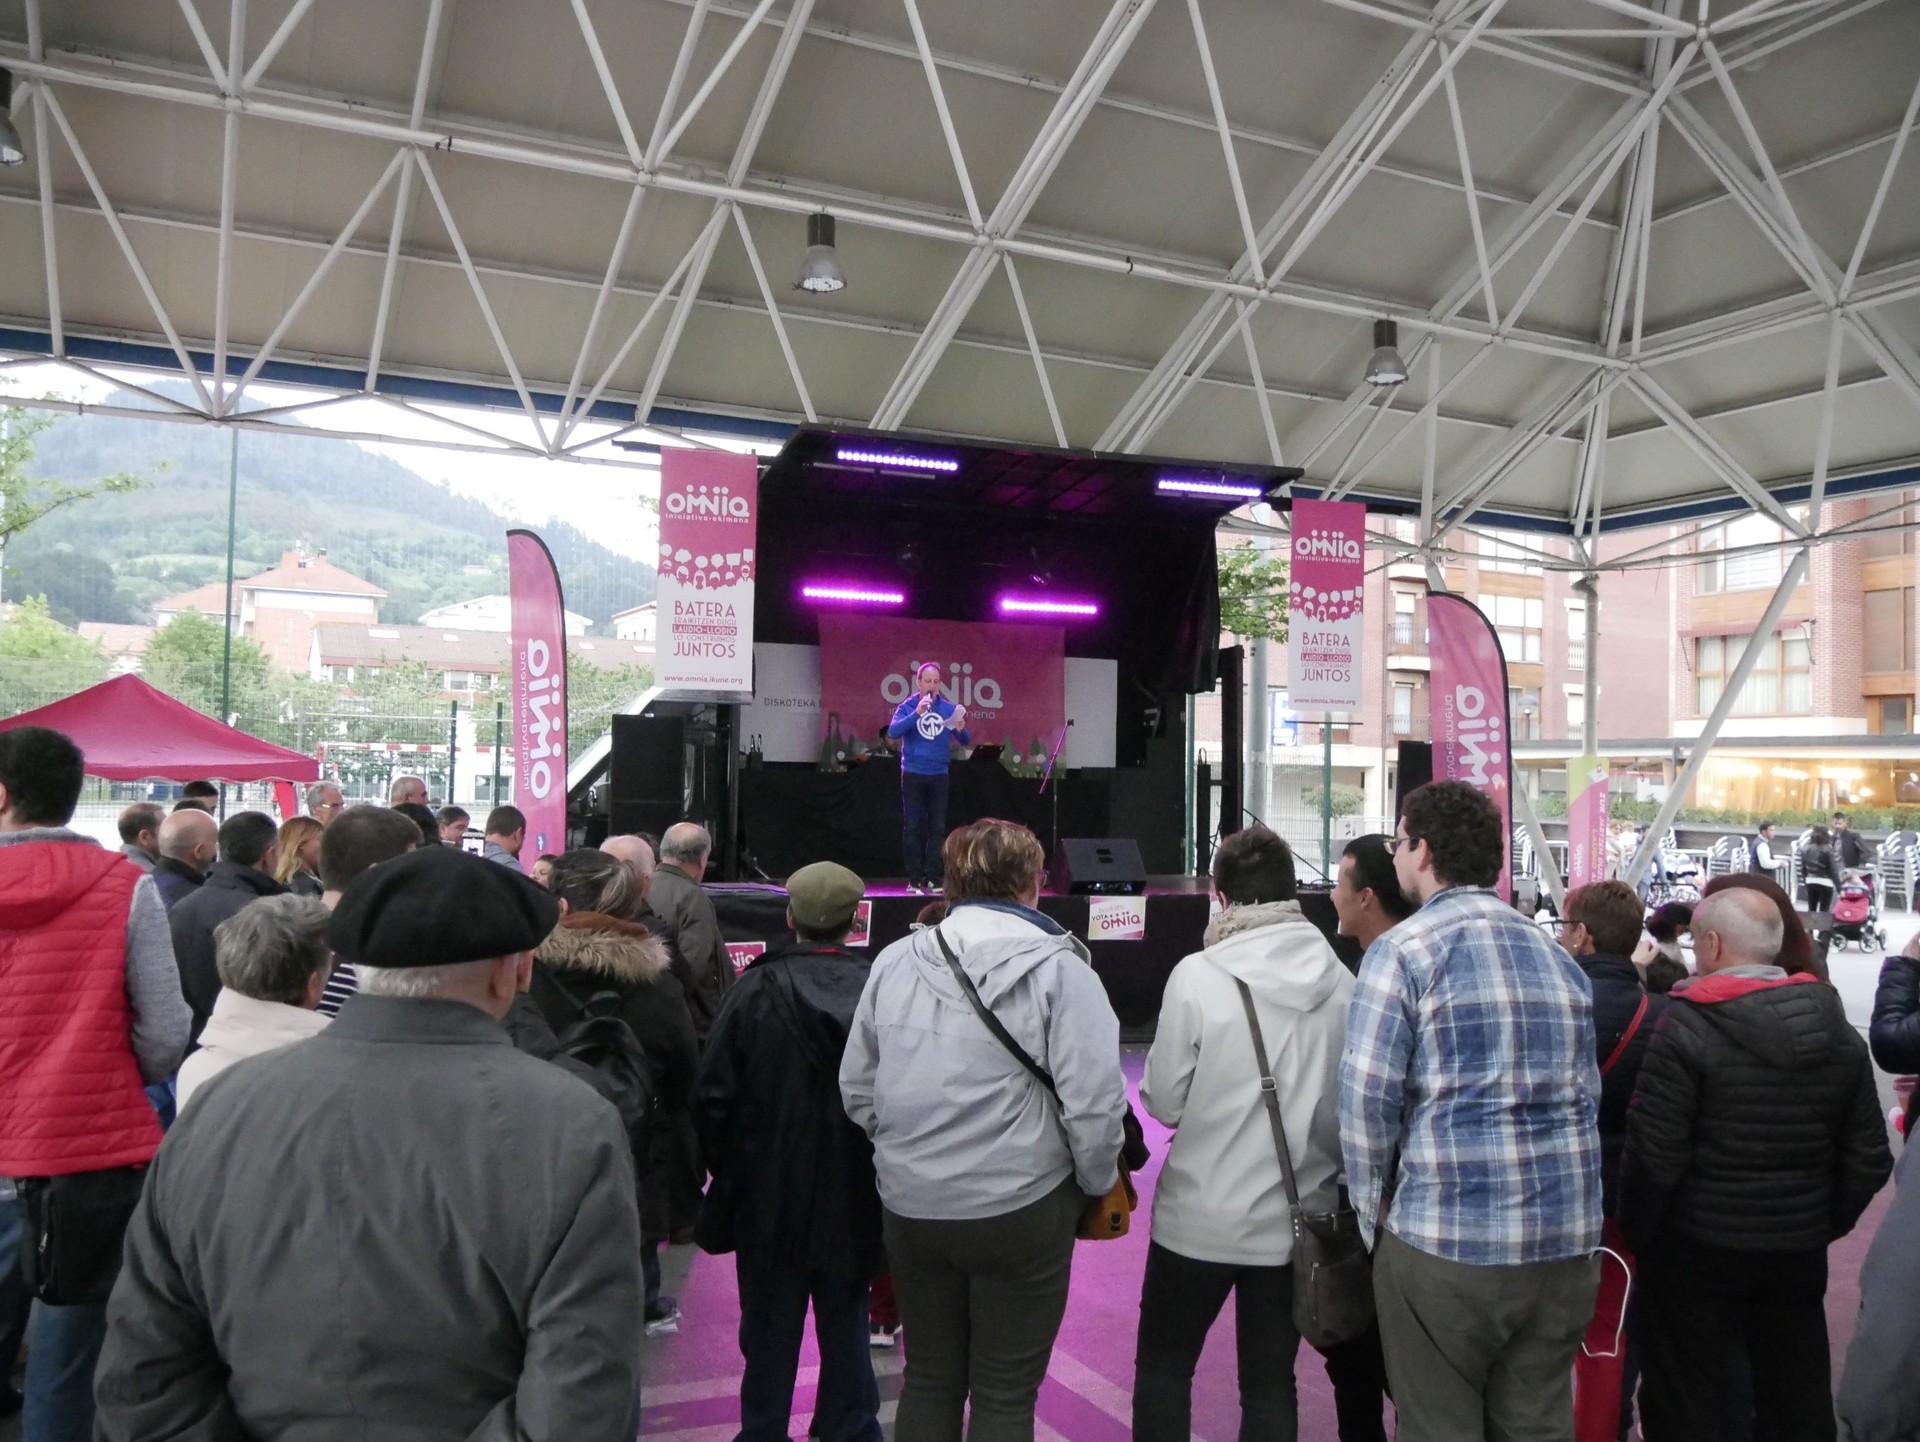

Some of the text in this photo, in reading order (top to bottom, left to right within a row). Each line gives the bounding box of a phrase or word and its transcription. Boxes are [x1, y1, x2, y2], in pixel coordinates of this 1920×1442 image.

[674, 600, 736, 617] BATERA
[673, 626, 736, 635] LAUDIO-LLODIO
[1302, 632, 1351, 647] BATERA
[673, 642, 736, 658] JUNTOS
[1302, 669, 1351, 682] JUNTOS
[763, 697, 816, 707] DISKOTEKA
